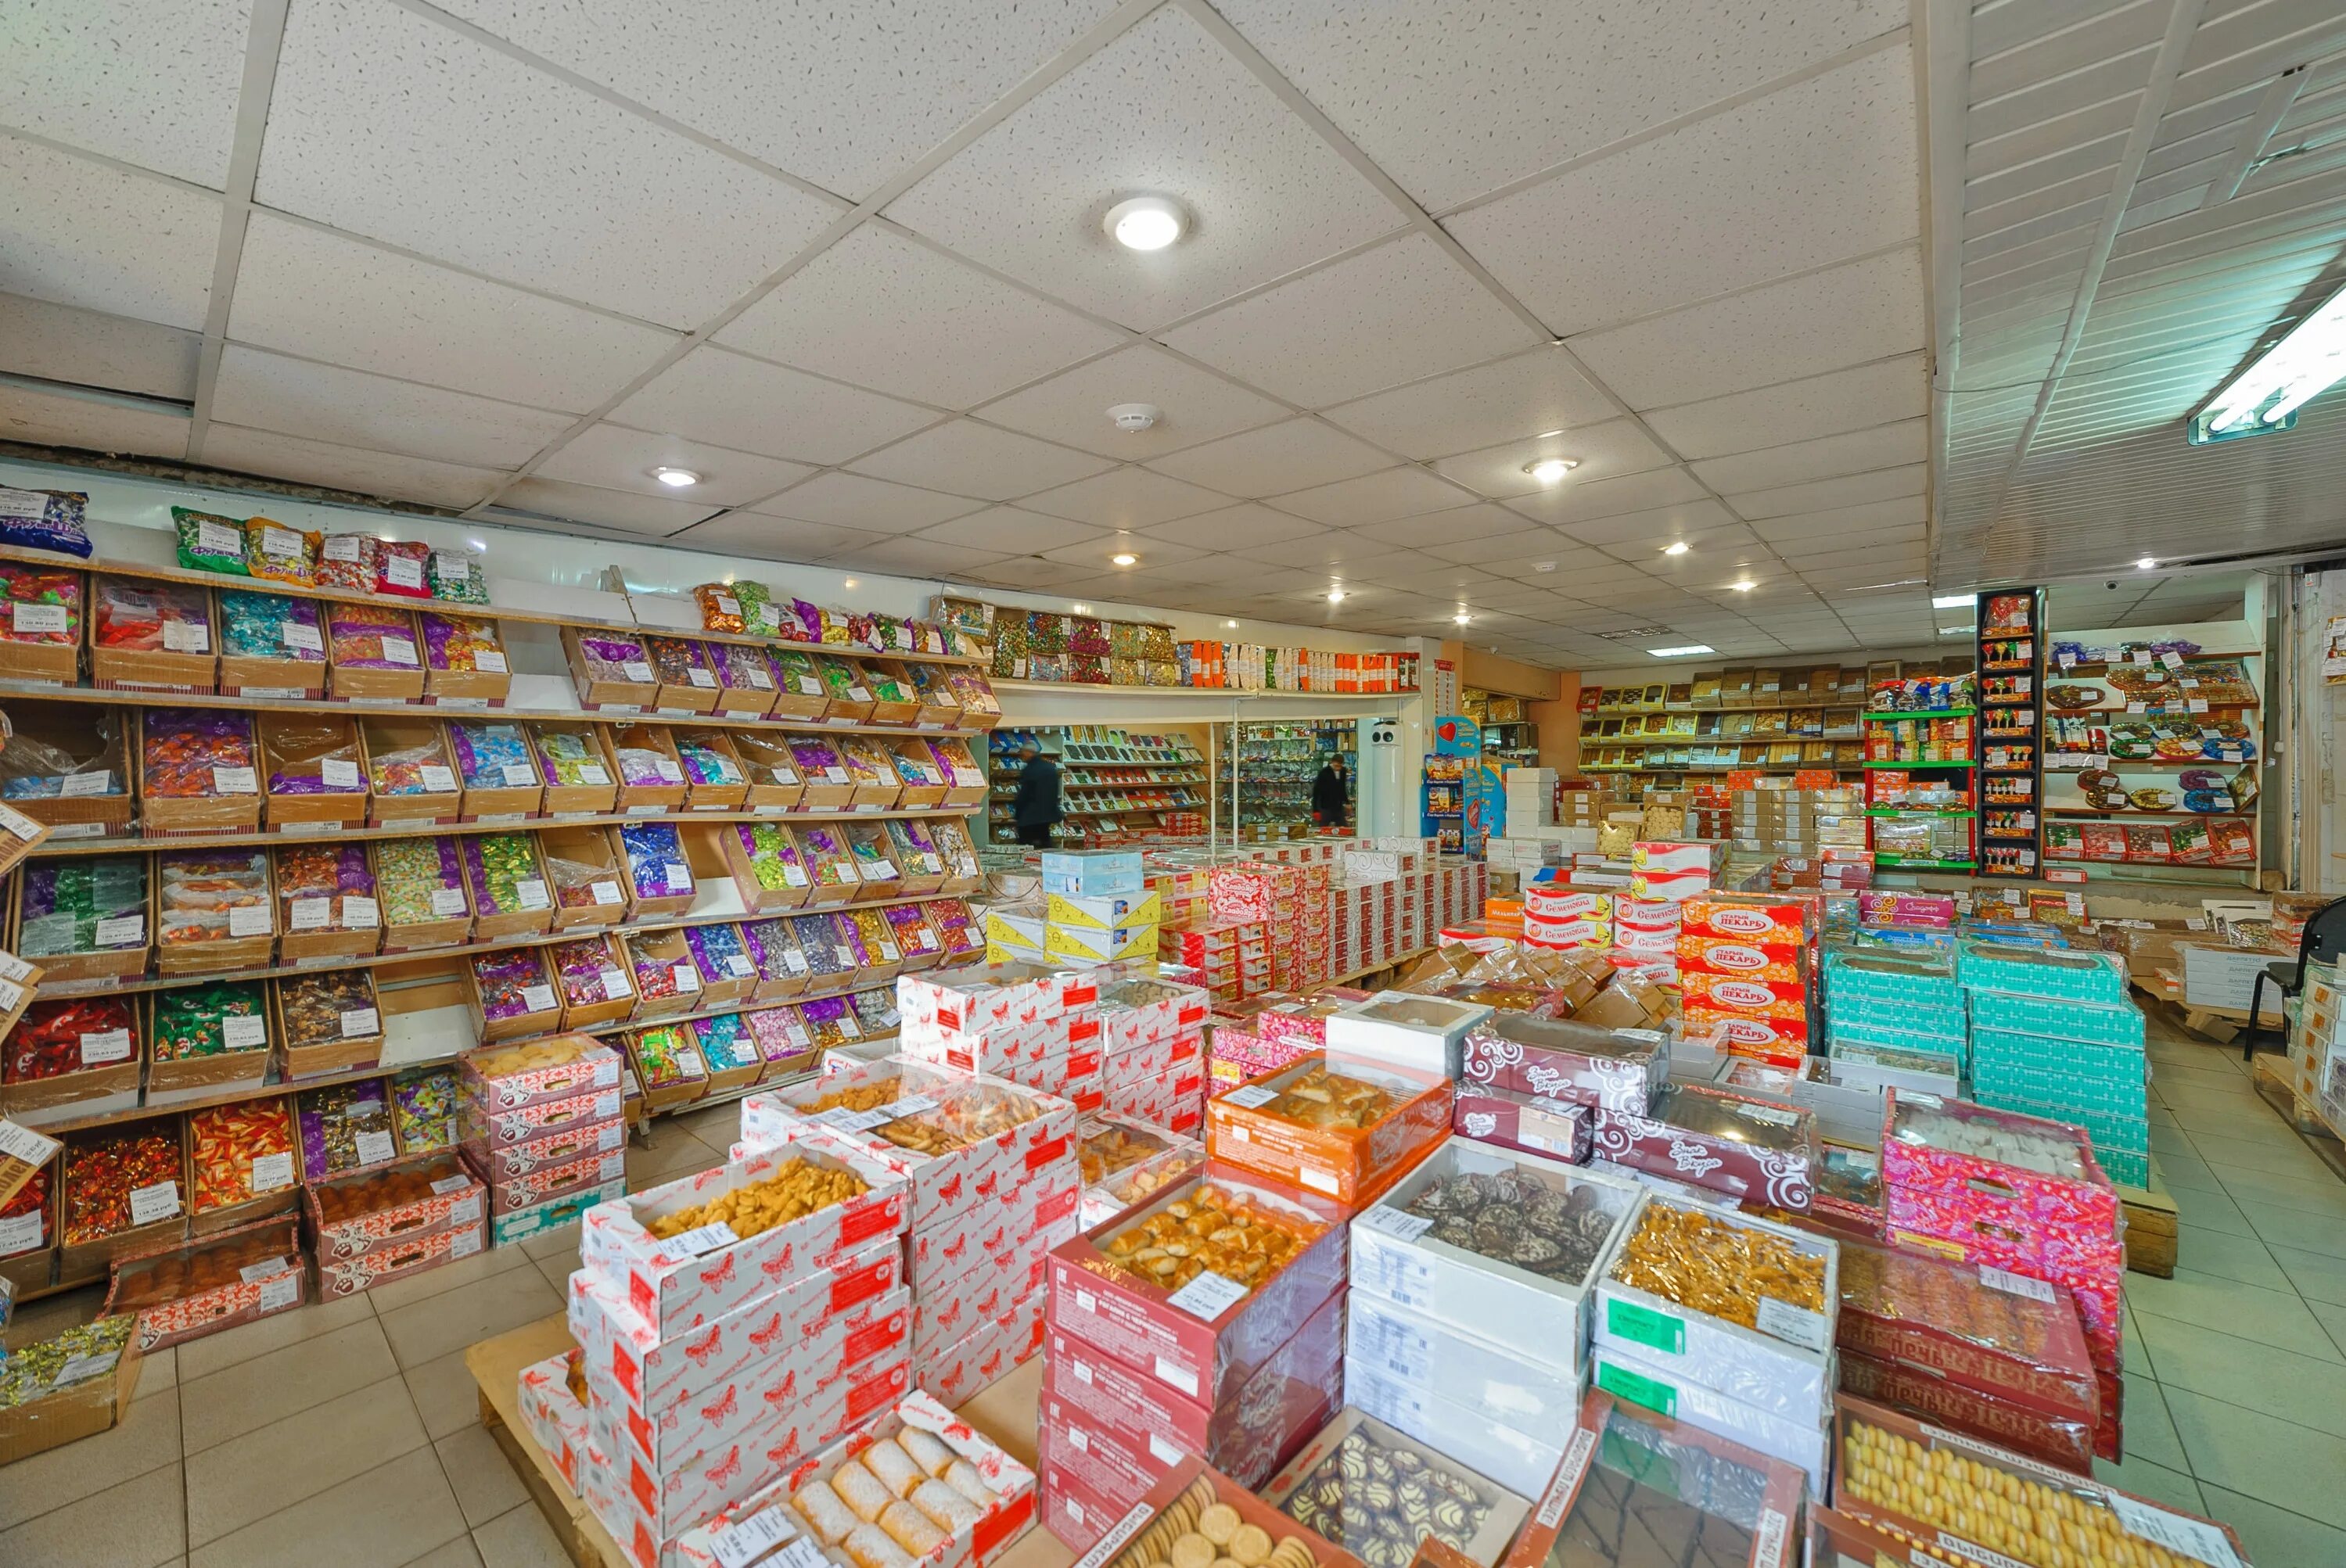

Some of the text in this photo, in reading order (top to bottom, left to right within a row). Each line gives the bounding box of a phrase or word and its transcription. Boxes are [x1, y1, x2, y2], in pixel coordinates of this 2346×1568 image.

[1720, 918, 1762, 928] ПЕКАРЬ
[1715, 953, 1757, 963] ПЕКАРЬ
[1722, 990, 1763, 1001] ПЕКАРЬ
